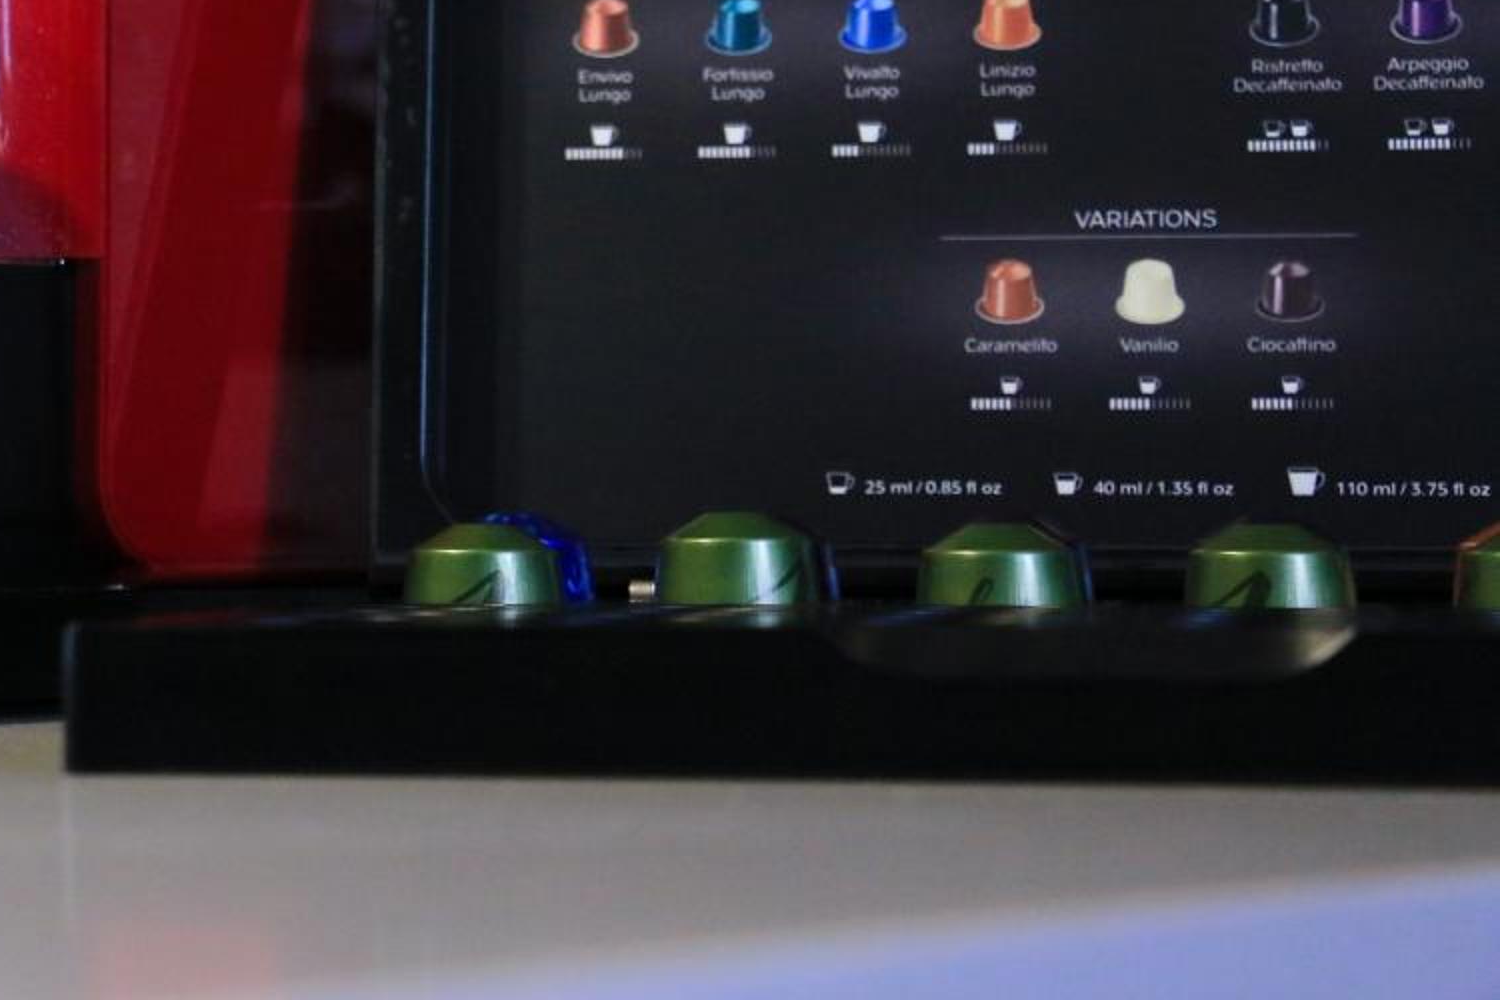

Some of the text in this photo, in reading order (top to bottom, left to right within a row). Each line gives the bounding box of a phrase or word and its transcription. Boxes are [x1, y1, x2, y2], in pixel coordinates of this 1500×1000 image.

[979, 63, 1037, 79] Linizio
[1251, 58, 1324, 74] Ristretto
[1387, 56, 1470, 74] Arpeggio
[577, 68, 634, 85] Envivo
[1233, 76, 1343, 93] Decaffeinato
[1373, 75, 1485, 91] Decaffeinato
[578, 88, 632, 105] Lungo
[710, 86, 766, 103] Lungo
[844, 83, 900, 101] Lungo
[979, 82, 1036, 99] Lungo
[1074, 208, 1218, 229] VARIATIONS
[963, 337, 1059, 354] Caramelito
[1119, 336, 1180, 353] Vanilio
[864, 479, 887, 495] 25
[980, 482, 1003, 496] oz
[1093, 480, 1116, 496] 40
[1157, 480, 1194, 496] 1.35
[1212, 483, 1234, 497] oz
[1337, 481, 1369, 497] 110
[1411, 481, 1449, 497] 3.75
[1469, 484, 1491, 497] oz
